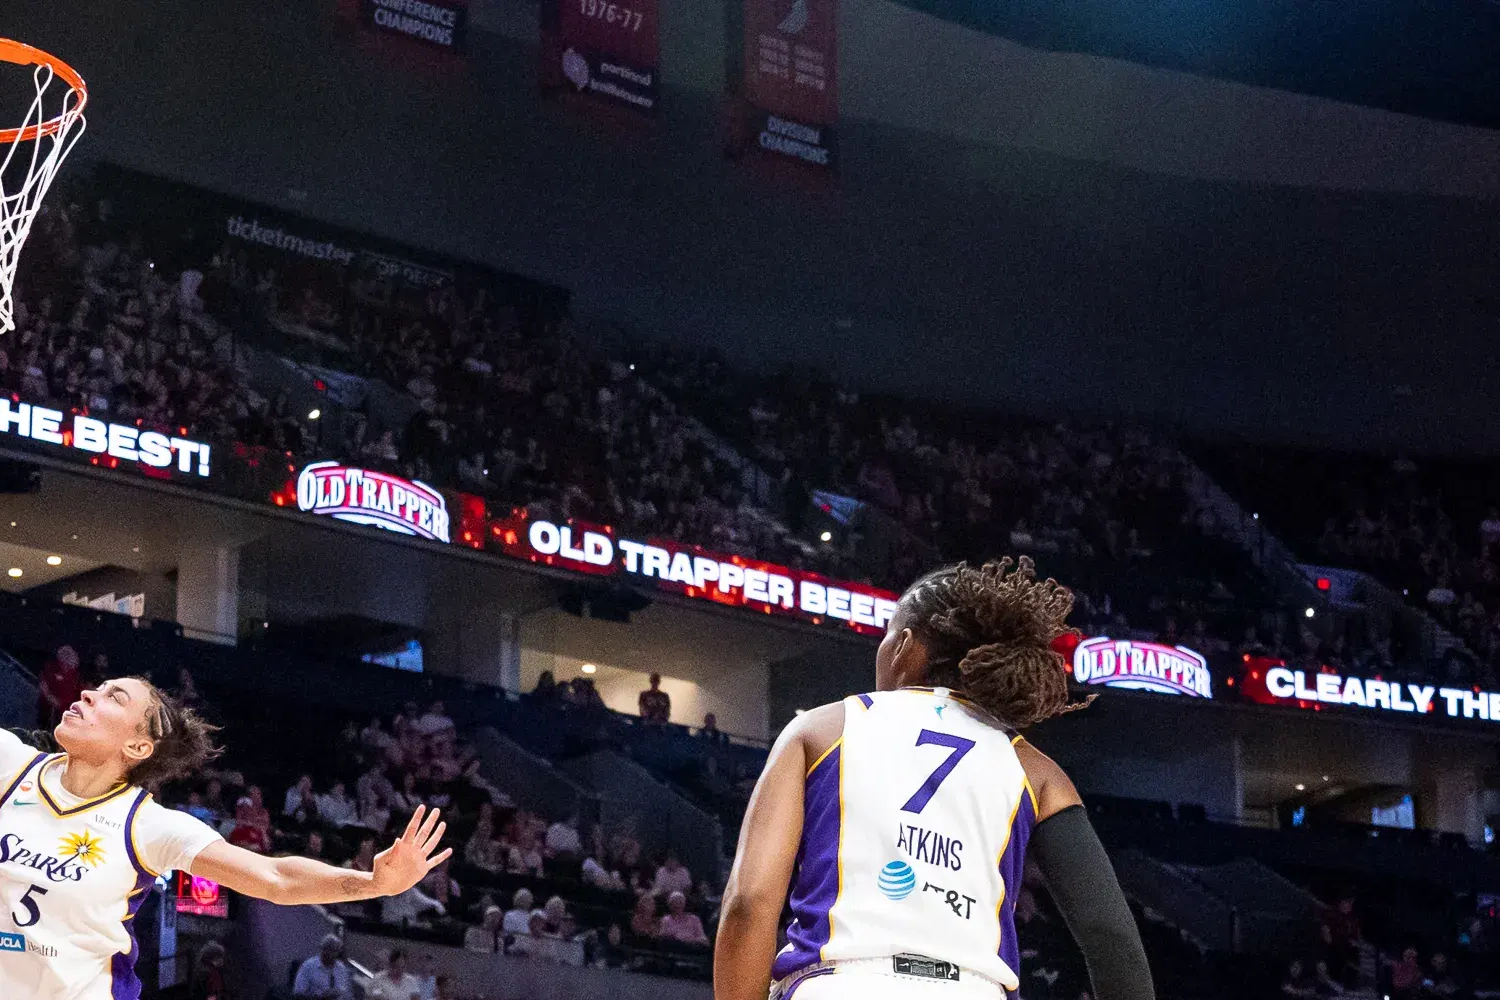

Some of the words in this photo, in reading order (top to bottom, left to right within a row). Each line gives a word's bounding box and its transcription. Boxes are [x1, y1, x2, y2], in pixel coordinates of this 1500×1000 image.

[373, 8, 453, 45] CHAMPIONS
[580, 0, 644, 31] 1976-77
[226, 215, 355, 265] ticketmaster
[73, 416, 211, 477] BEST!
[300, 471, 345, 511] OLD
[345, 468, 450, 543] TRAPPER
[529, 520, 613, 566] OLD
[619, 540, 795, 608] TRAPPER
[800, 581, 900, 629] BEEF
[1077, 646, 1117, 684] OLD
[1116, 641, 1212, 698] TRAPPER
[1265, 667, 1435, 713] CLEARLY
[900, 728, 976, 815] 7
[897, 822, 963, 872] ATKINS
[11, 883, 48, 927] 5
